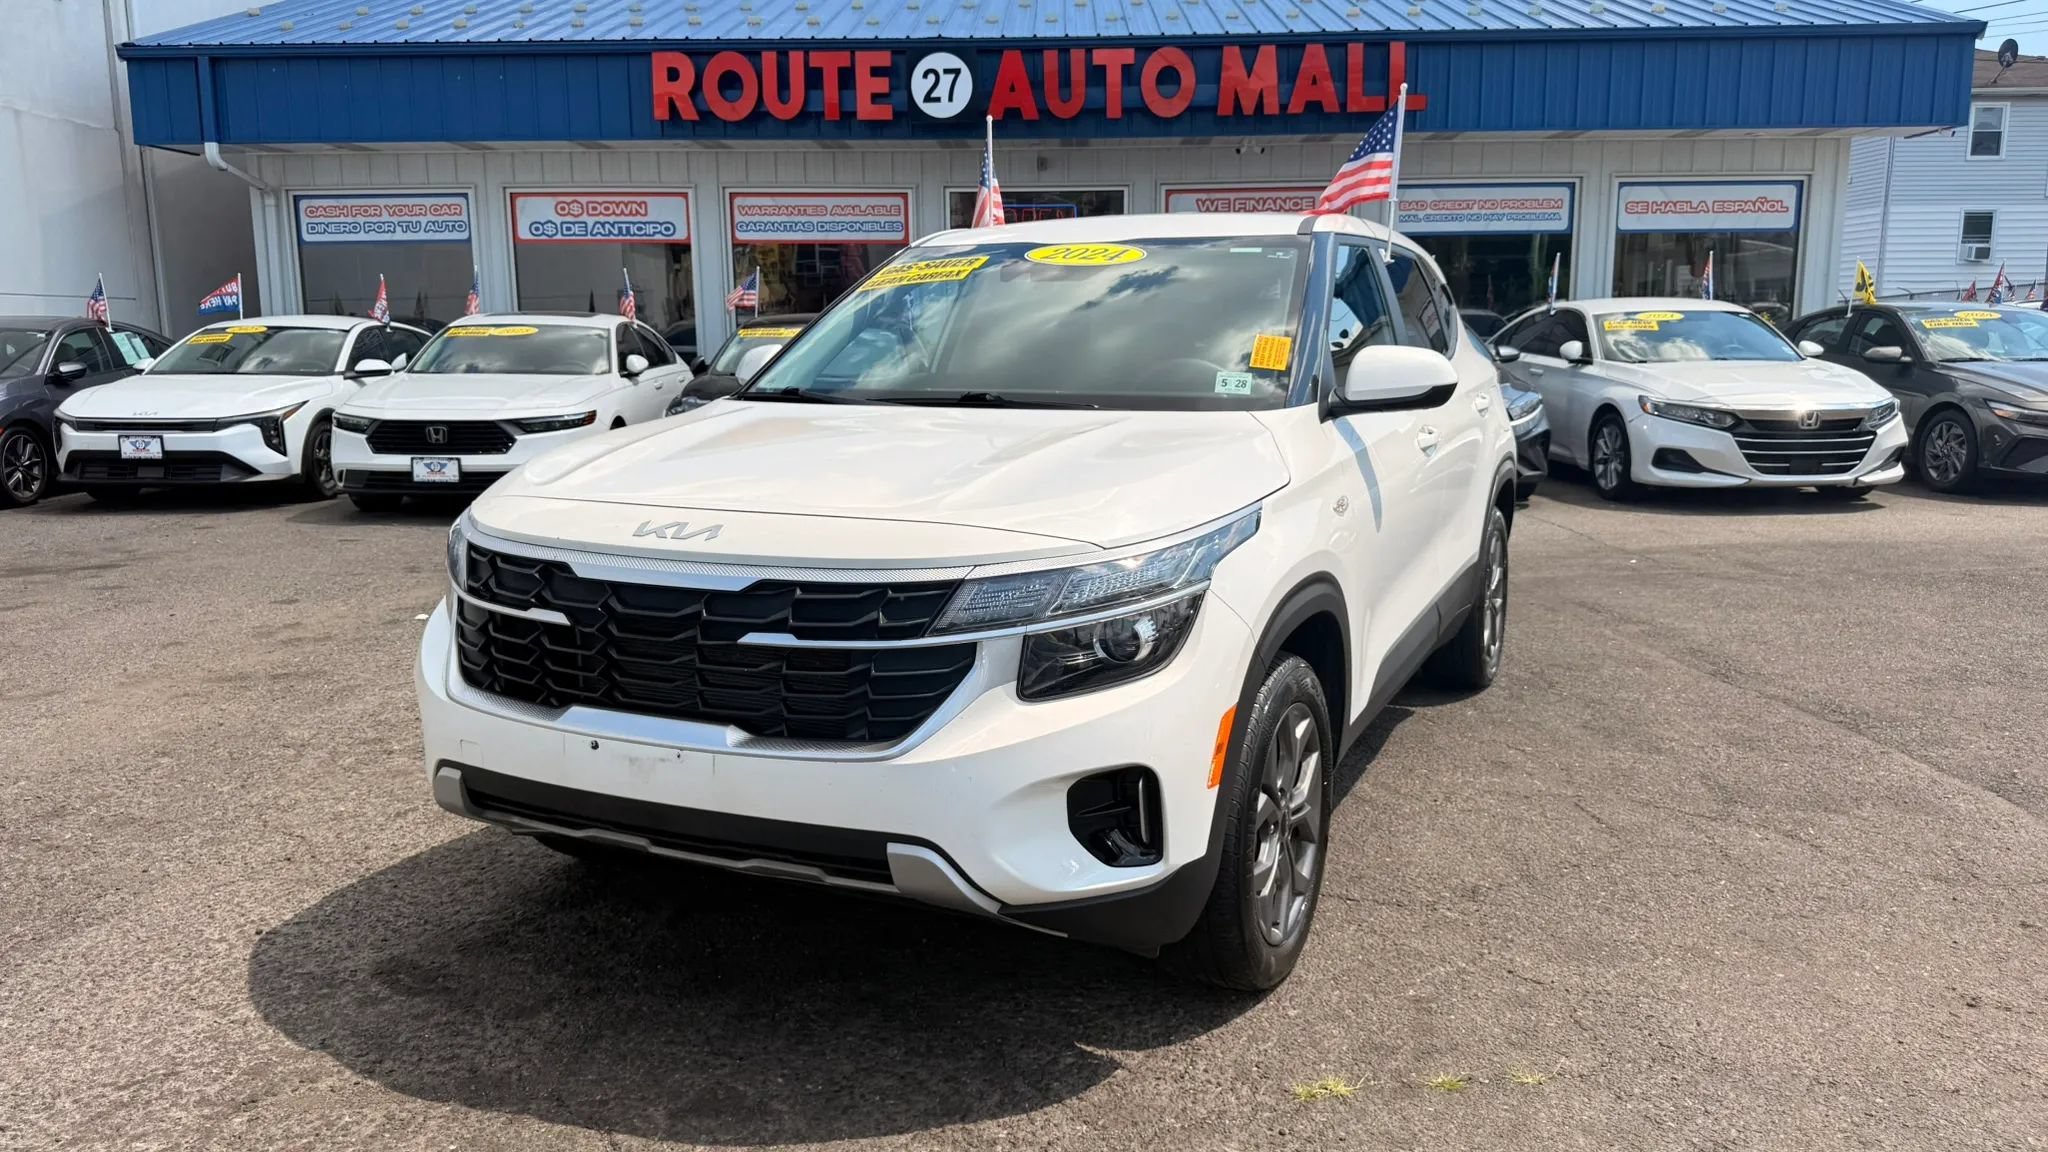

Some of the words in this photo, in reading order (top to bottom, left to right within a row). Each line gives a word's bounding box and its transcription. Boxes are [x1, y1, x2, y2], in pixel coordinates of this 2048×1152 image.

[652, 50, 896, 121] ROUTE
[922, 68, 961, 103] 27
[987, 46, 1196, 120] AUTO
[1217, 42, 1426, 116] MALL
[305, 205, 347, 217] CASH
[351, 205, 382, 217] FOR
[384, 205, 426, 216] YOUR
[429, 204, 462, 216] CAR
[586, 201, 647, 216] DOWN
[1196, 198, 1231, 212] WE
[1233, 197, 1315, 212] FINANCE
[1399, 200, 1427, 211] BAD
[1429, 199, 1477, 210] CREDIT
[1478, 199, 1497, 210] NO
[1500, 198, 1563, 210] PROBLEM
[1625, 201, 1649, 214] SE
[1651, 201, 1709, 213] HABLA
[1712, 196, 1789, 213] ESPAÑOL
[1423, 213, 1464, 222] CREDITO
[1466, 213, 1481, 222] NO
[1483, 213, 1505, 222] HAY
[1506, 212, 1562, 221] PROBLEMA
[307, 222, 360, 234] DINERO
[363, 221, 396, 233] POR
[397, 221, 420, 233] TU
[424, 220, 467, 232] AUTO
[561, 221, 588, 236] DE
[590, 221, 676, 236] ANTICIPO
[736, 221, 815, 232] GARANTIAS
[816, 221, 903, 232] DISPONIBLES
[1040, 247, 1129, 260] 2024
[1221, 378, 1228, 387] 5
[1234, 379, 1247, 388] 28
